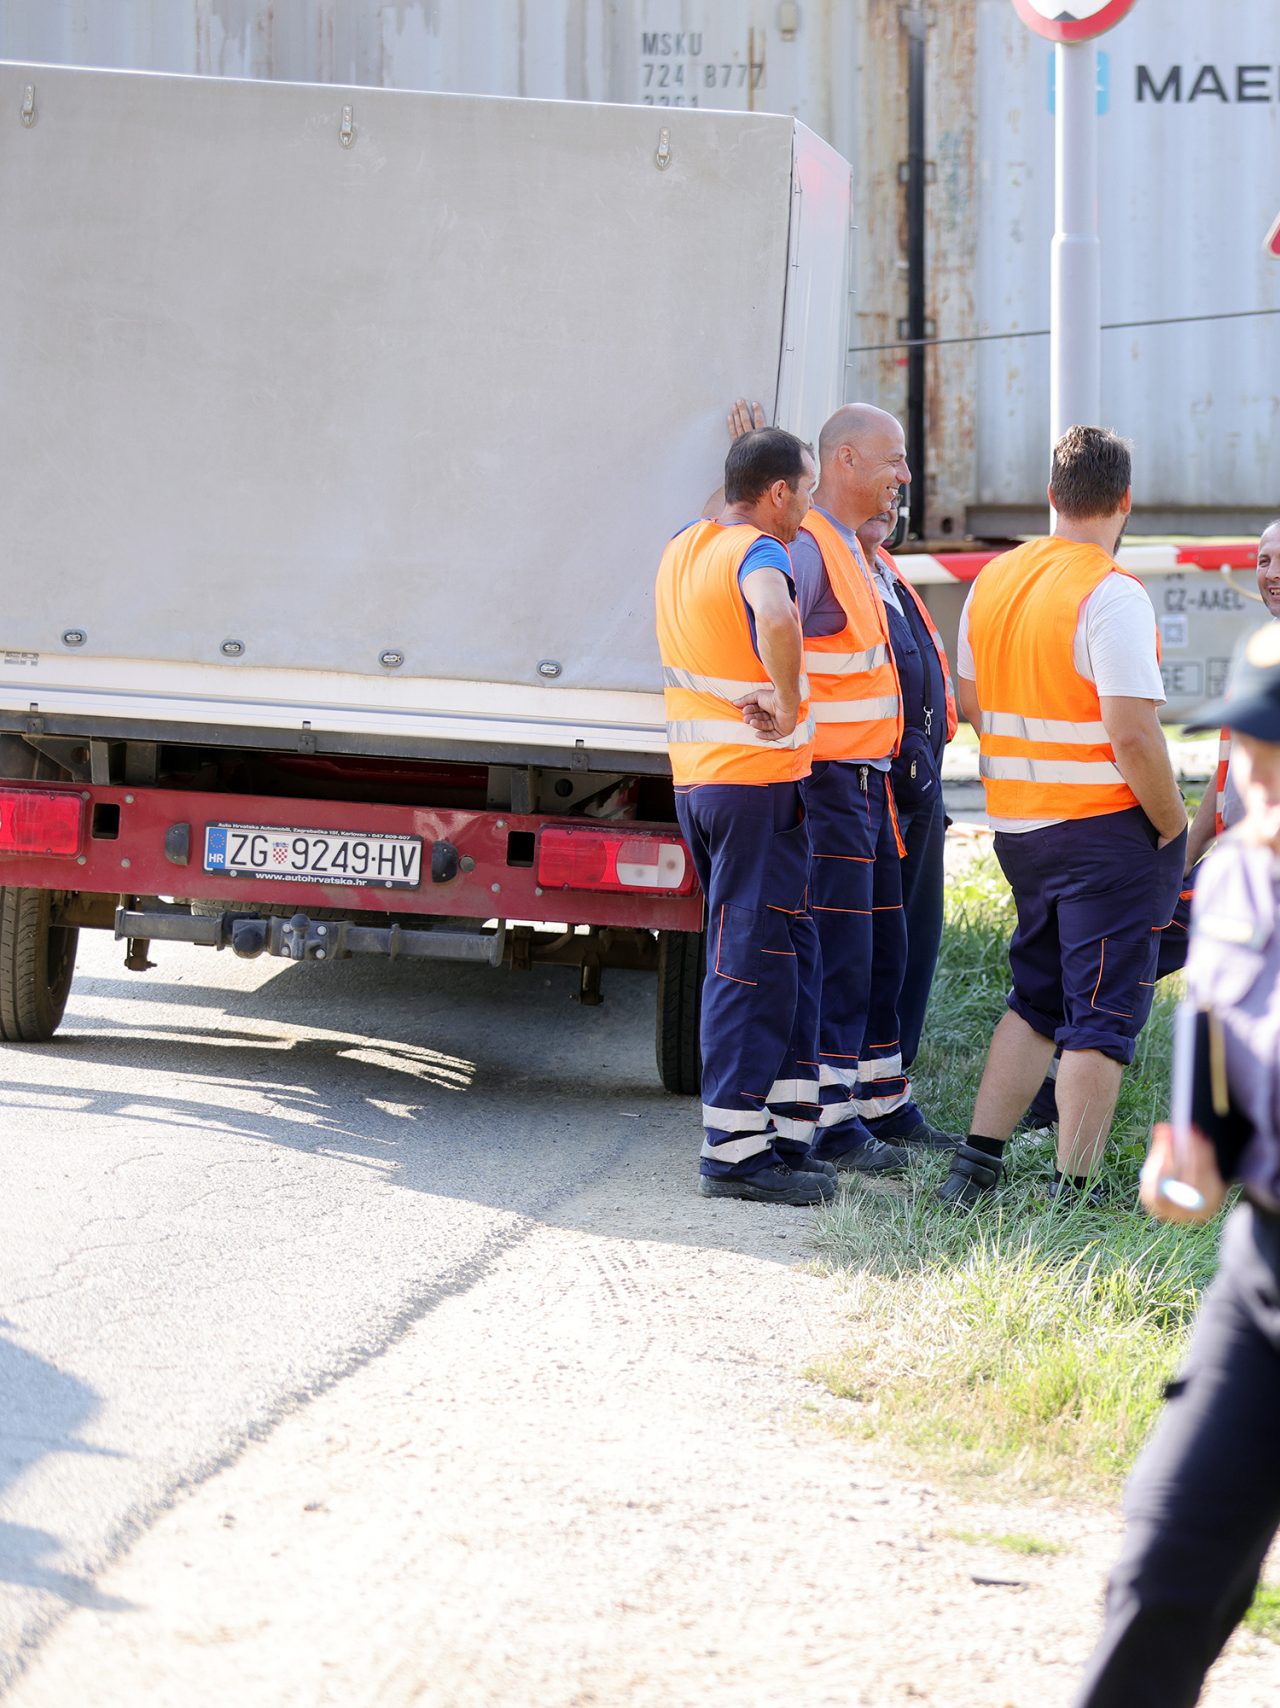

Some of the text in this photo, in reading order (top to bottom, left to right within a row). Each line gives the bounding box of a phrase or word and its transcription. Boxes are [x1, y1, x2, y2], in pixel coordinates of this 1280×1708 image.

[641, 32, 703, 57] MSKU
[642, 63, 764, 89] 724 8777
[208, 853, 224, 864] HR
[230, 833, 269, 868] ZG
[255, 872, 368, 887] www.autohrvatska.hr
